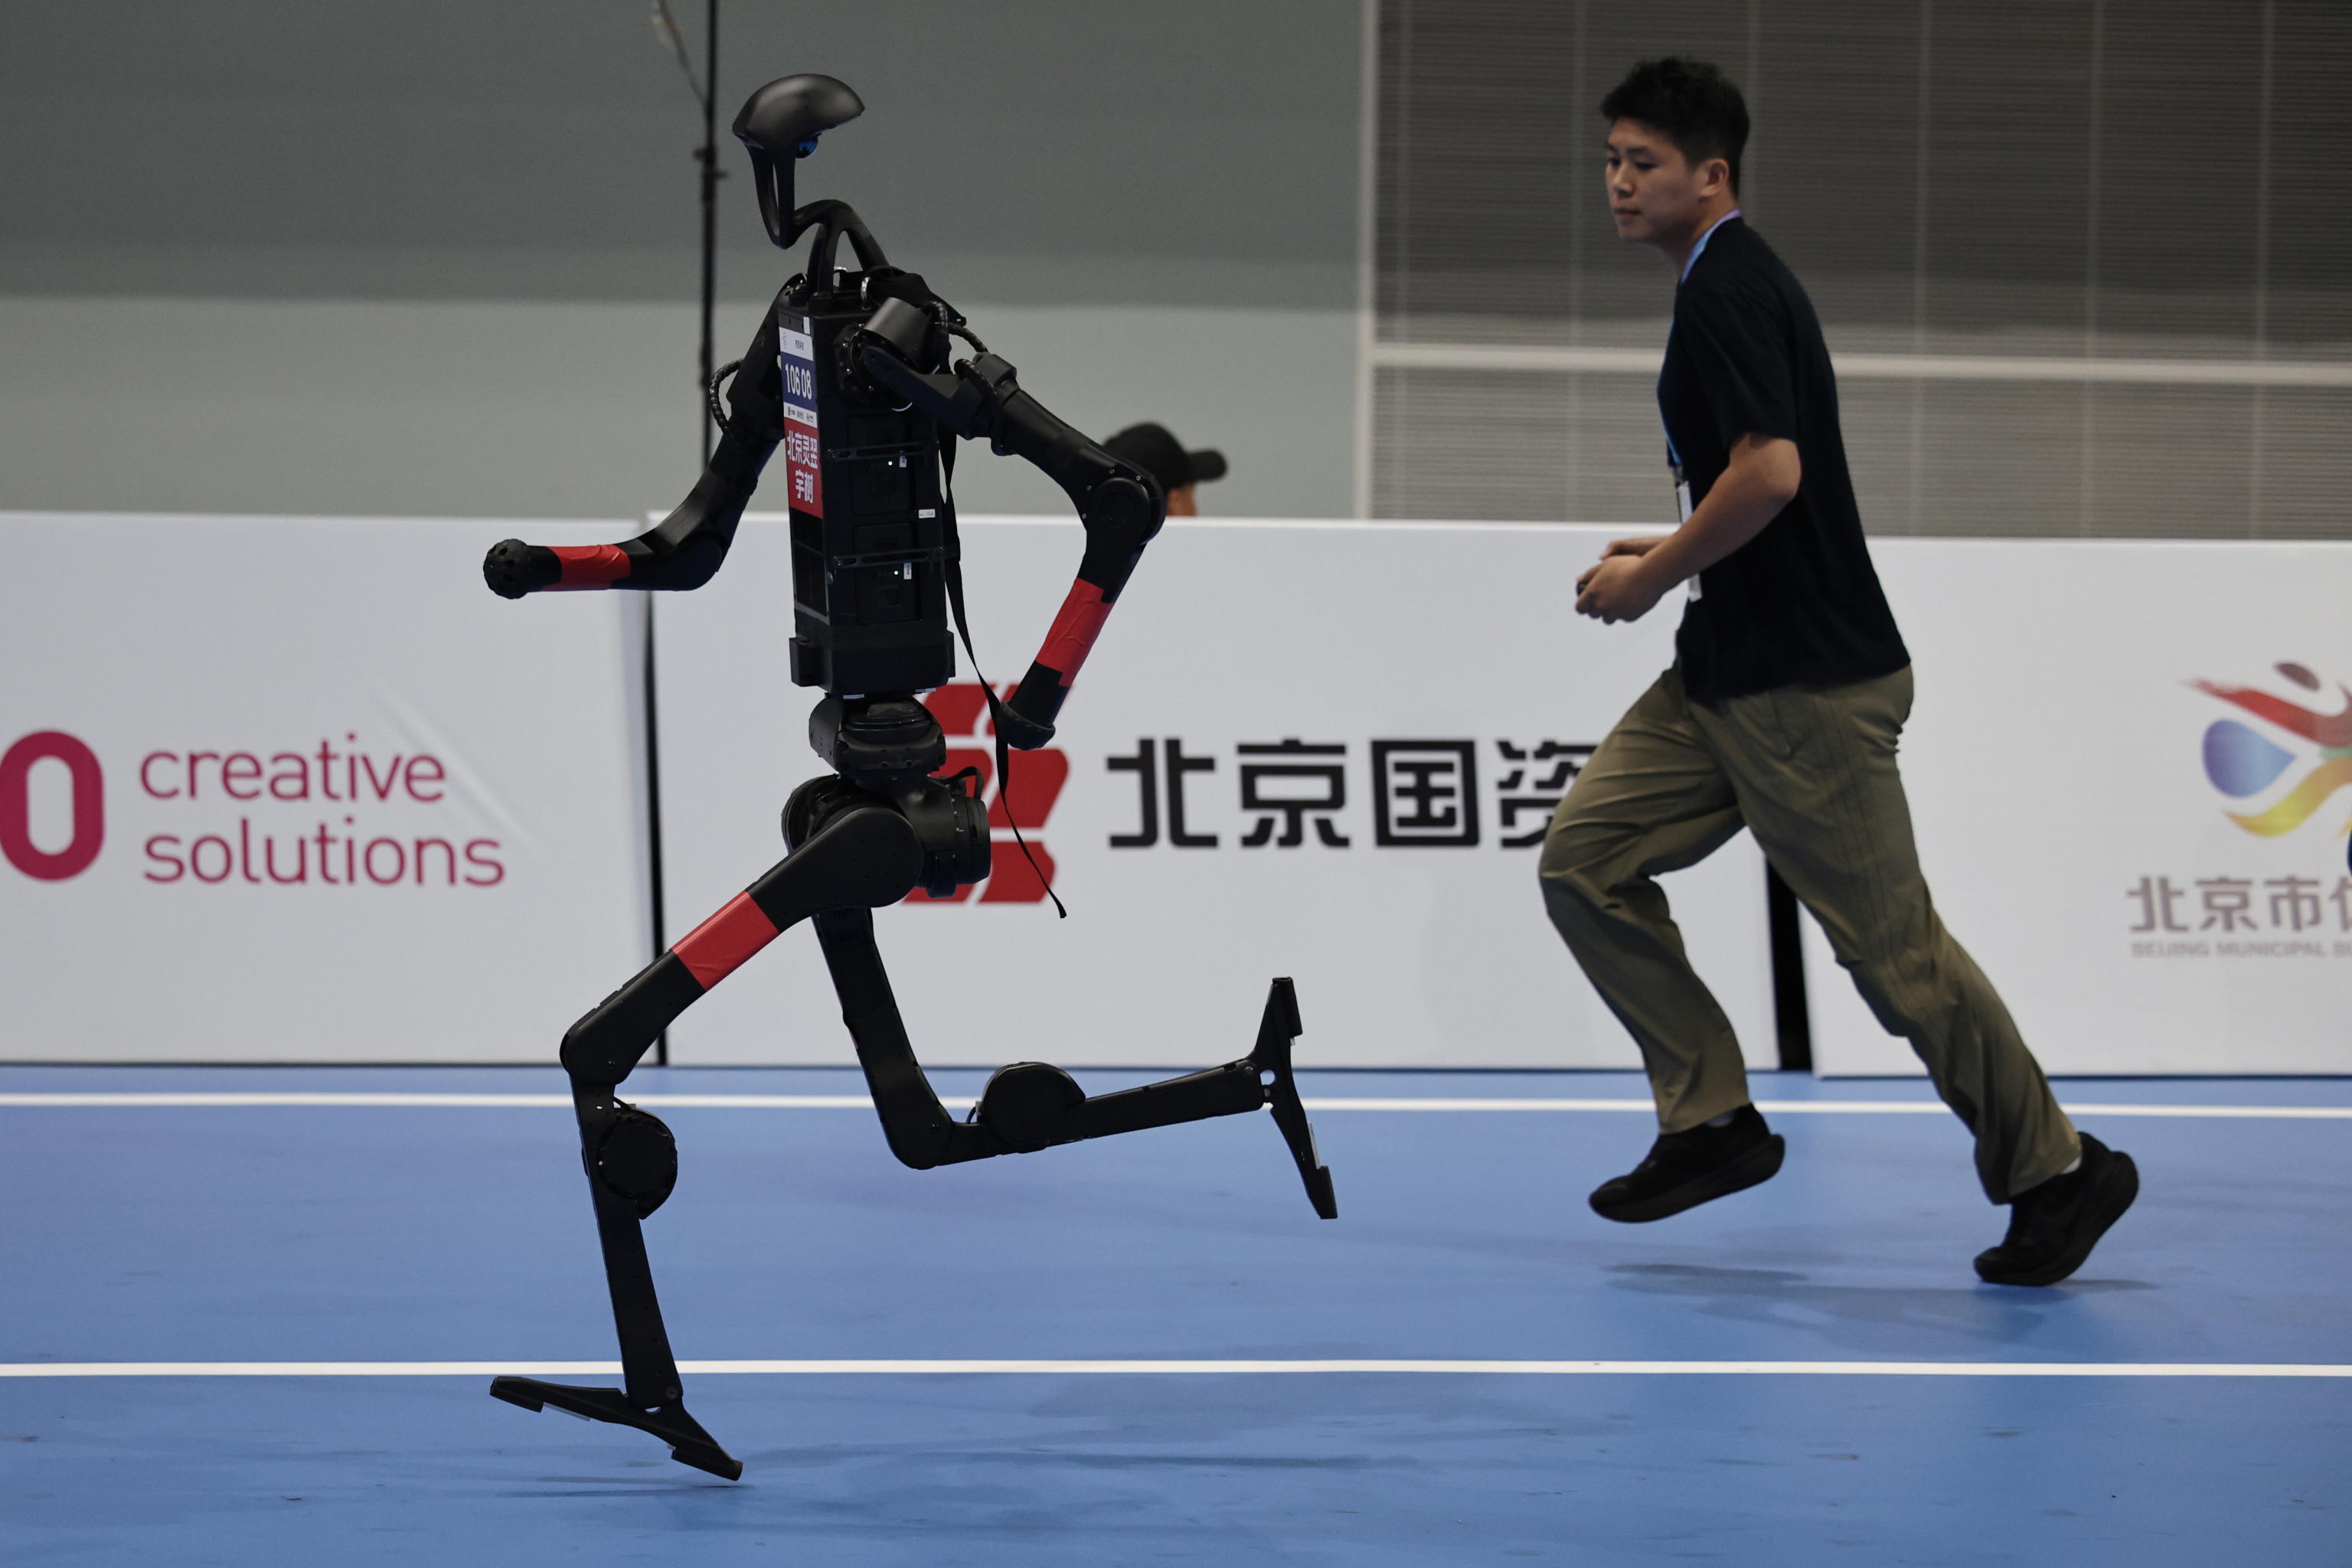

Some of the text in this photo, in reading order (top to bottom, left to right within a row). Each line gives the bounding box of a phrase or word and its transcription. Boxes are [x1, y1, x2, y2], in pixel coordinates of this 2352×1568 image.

[785, 363, 812, 400] 10608
[139, 732, 446, 802] creative
[144, 815, 505, 887] solutions
